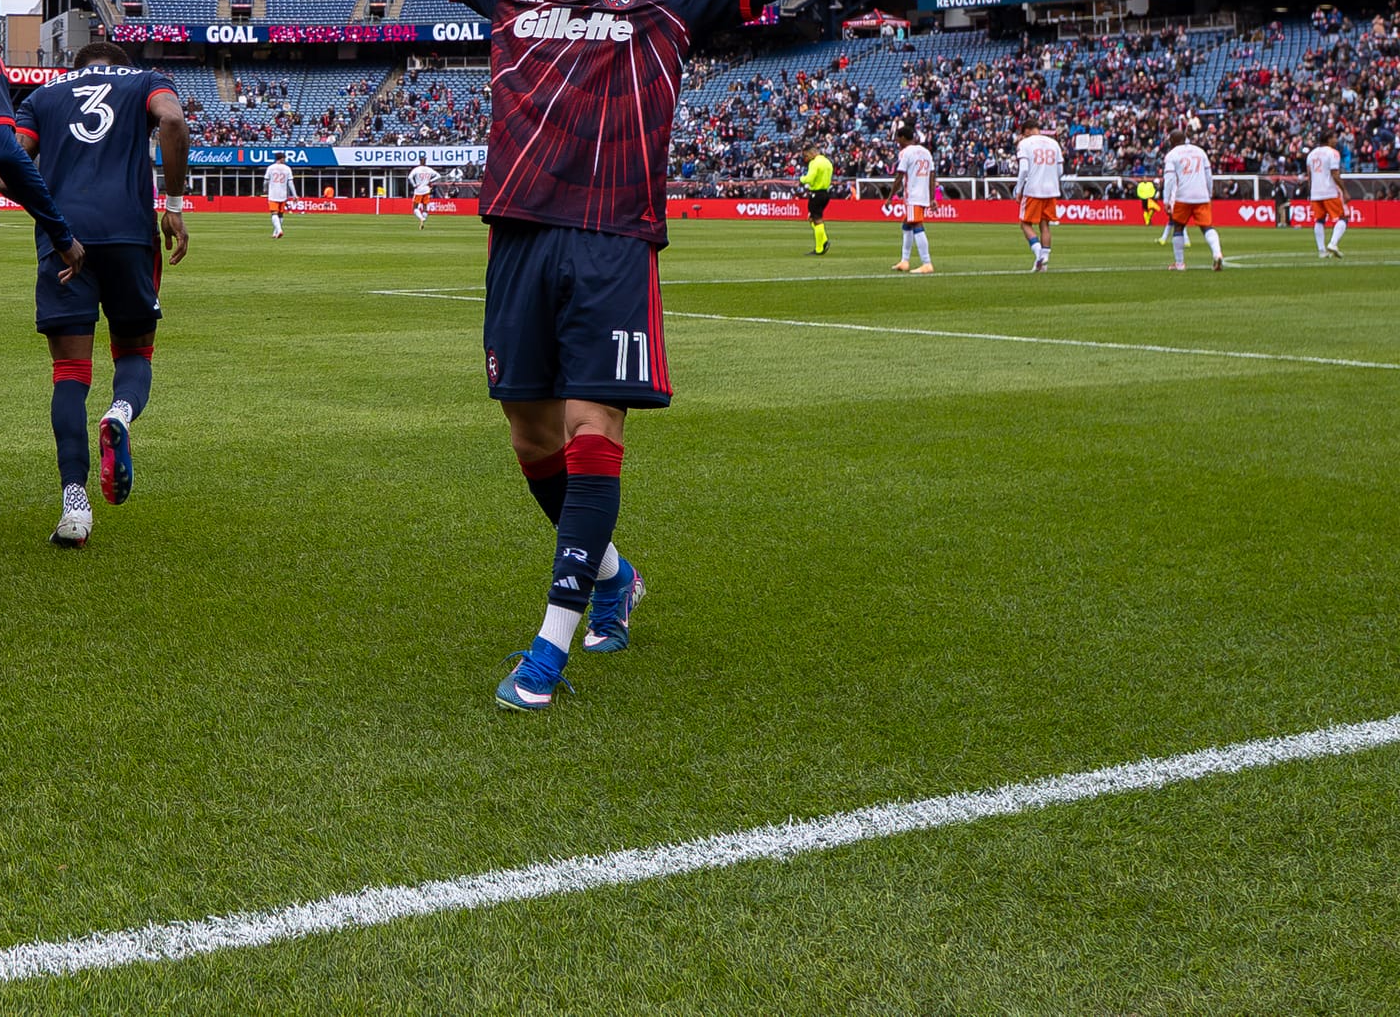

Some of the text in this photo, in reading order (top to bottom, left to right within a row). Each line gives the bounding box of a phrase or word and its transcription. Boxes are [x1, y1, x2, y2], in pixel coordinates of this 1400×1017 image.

[206, 25, 258, 43] GOAL
[432, 23, 484, 41] GOAL
[513, 7, 634, 42] Gillette
[7, 67, 64, 83] TOYOTA
[69, 83, 115, 143] 3
[188, 149, 309, 164] Michelob ULTRA
[355, 150, 426, 163] SUPERIOR
[432, 150, 473, 163] LIGHT
[1032, 149, 1056, 166] 88
[1179, 156, 1202, 175] 27
[271, 171, 286, 184] 22
[612, 329, 650, 382] 11
